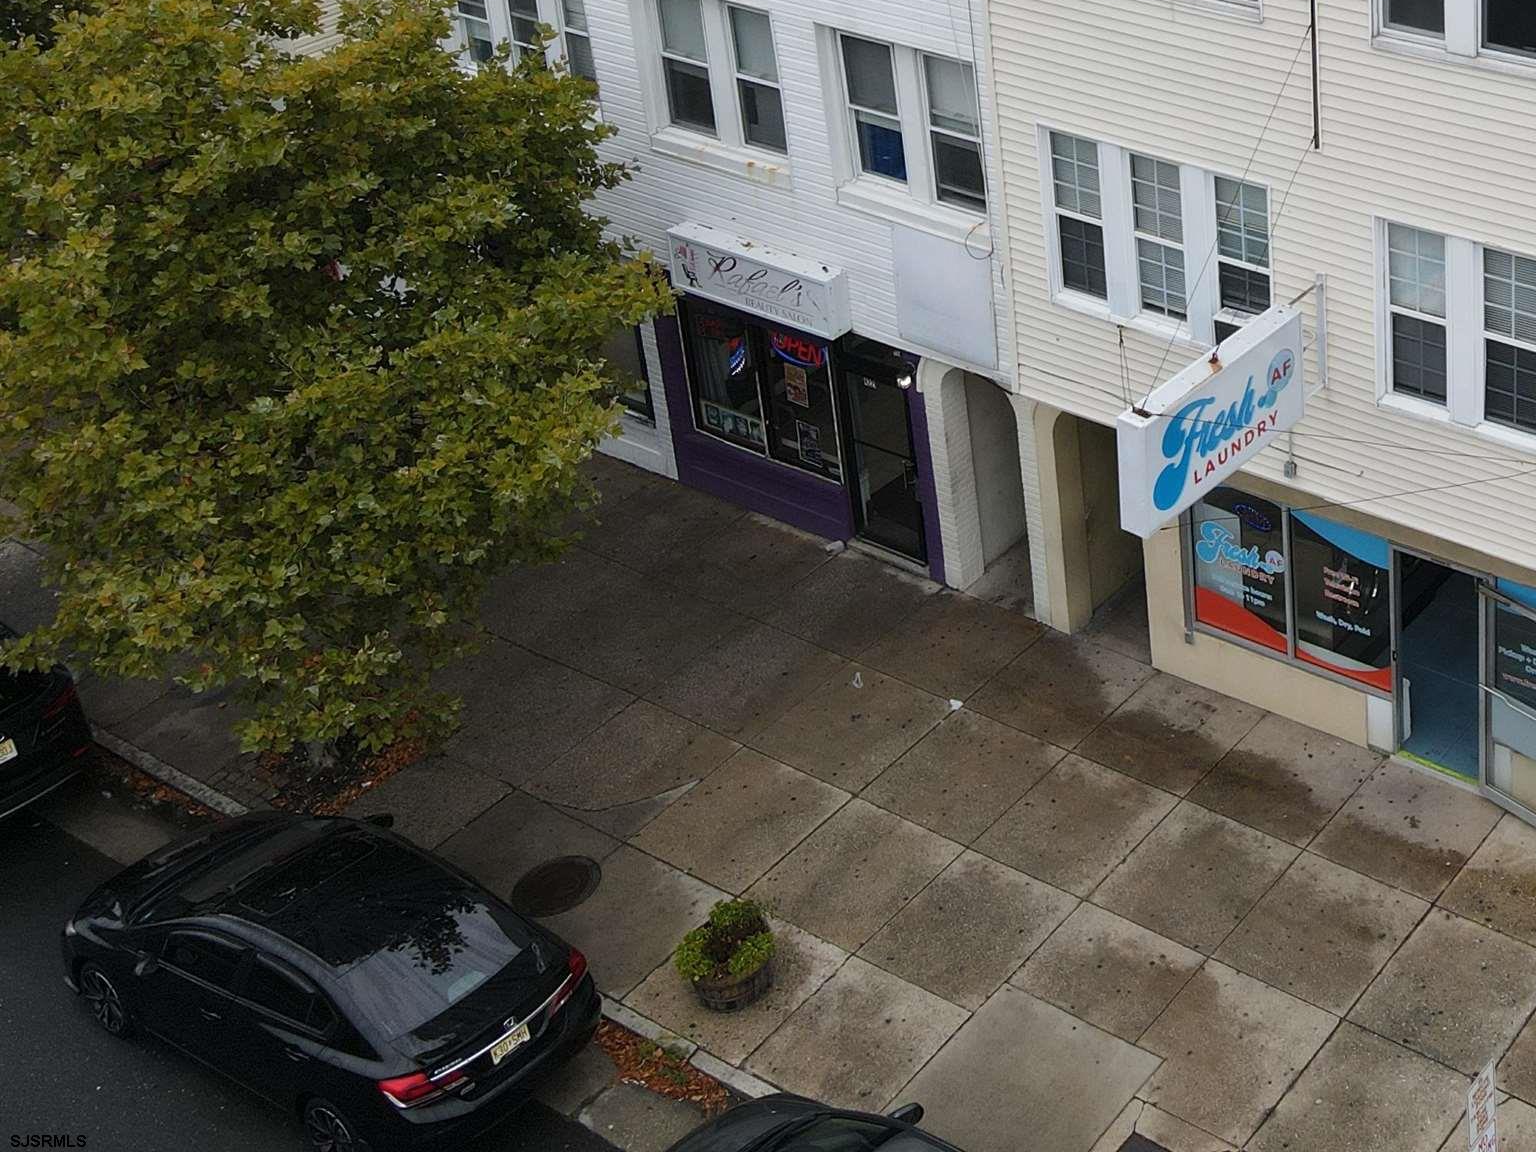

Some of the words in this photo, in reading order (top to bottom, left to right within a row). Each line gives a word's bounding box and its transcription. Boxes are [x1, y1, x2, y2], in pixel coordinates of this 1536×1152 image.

[1271, 358, 1291, 385] AF
[1153, 375, 1256, 510] Fresh
[1194, 410, 1278, 484] LAUNDRY
[1196, 520, 1262, 563] Fresh
